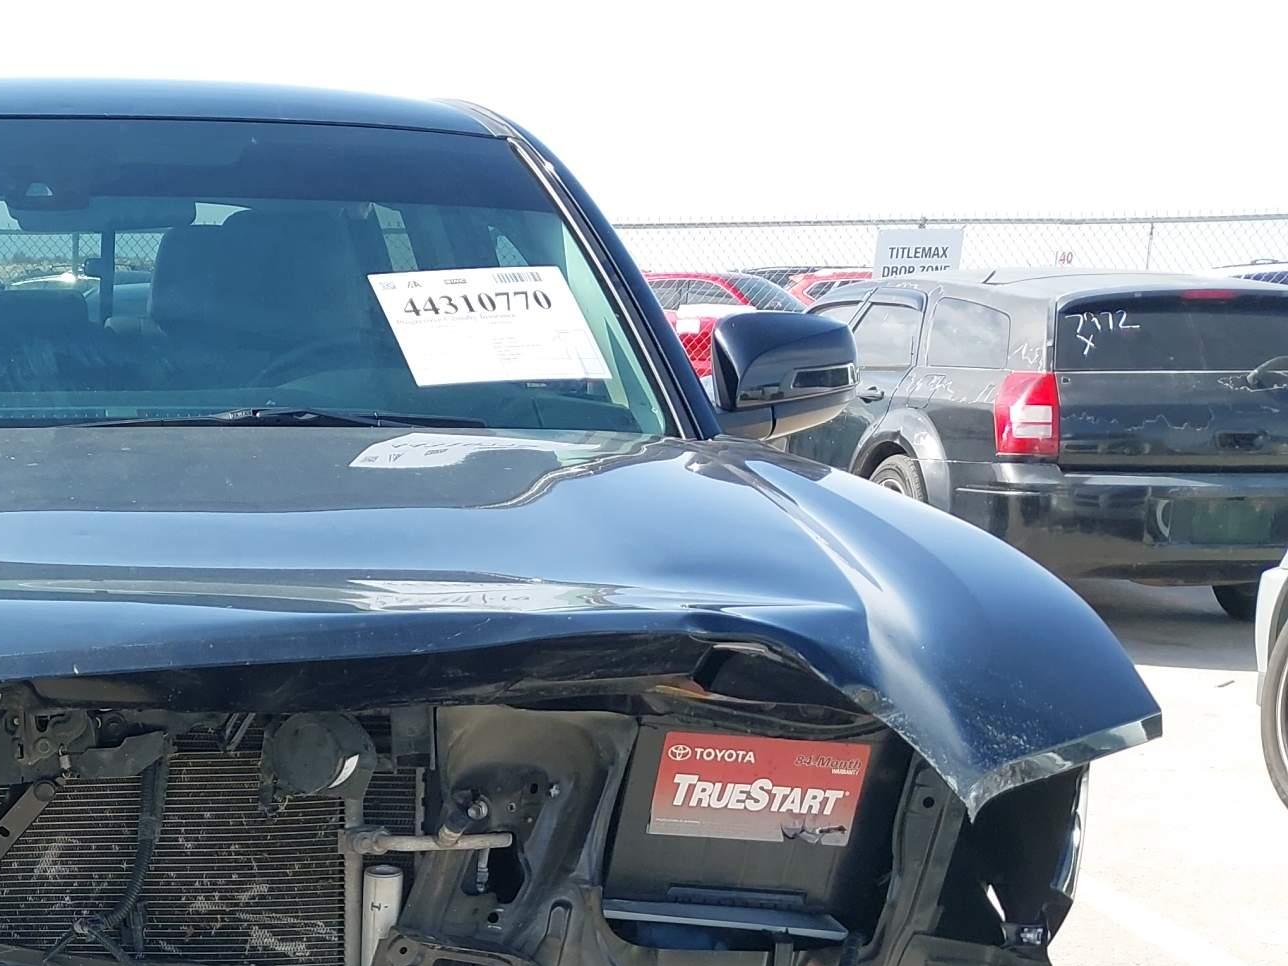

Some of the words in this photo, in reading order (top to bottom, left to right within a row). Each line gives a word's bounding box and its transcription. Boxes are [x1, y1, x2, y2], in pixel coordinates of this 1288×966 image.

[889, 246, 950, 259] TITLEMAX
[881, 265, 916, 278] DROP
[403, 289, 552, 317] 44310770
[694, 748, 756, 764] TOYOTA
